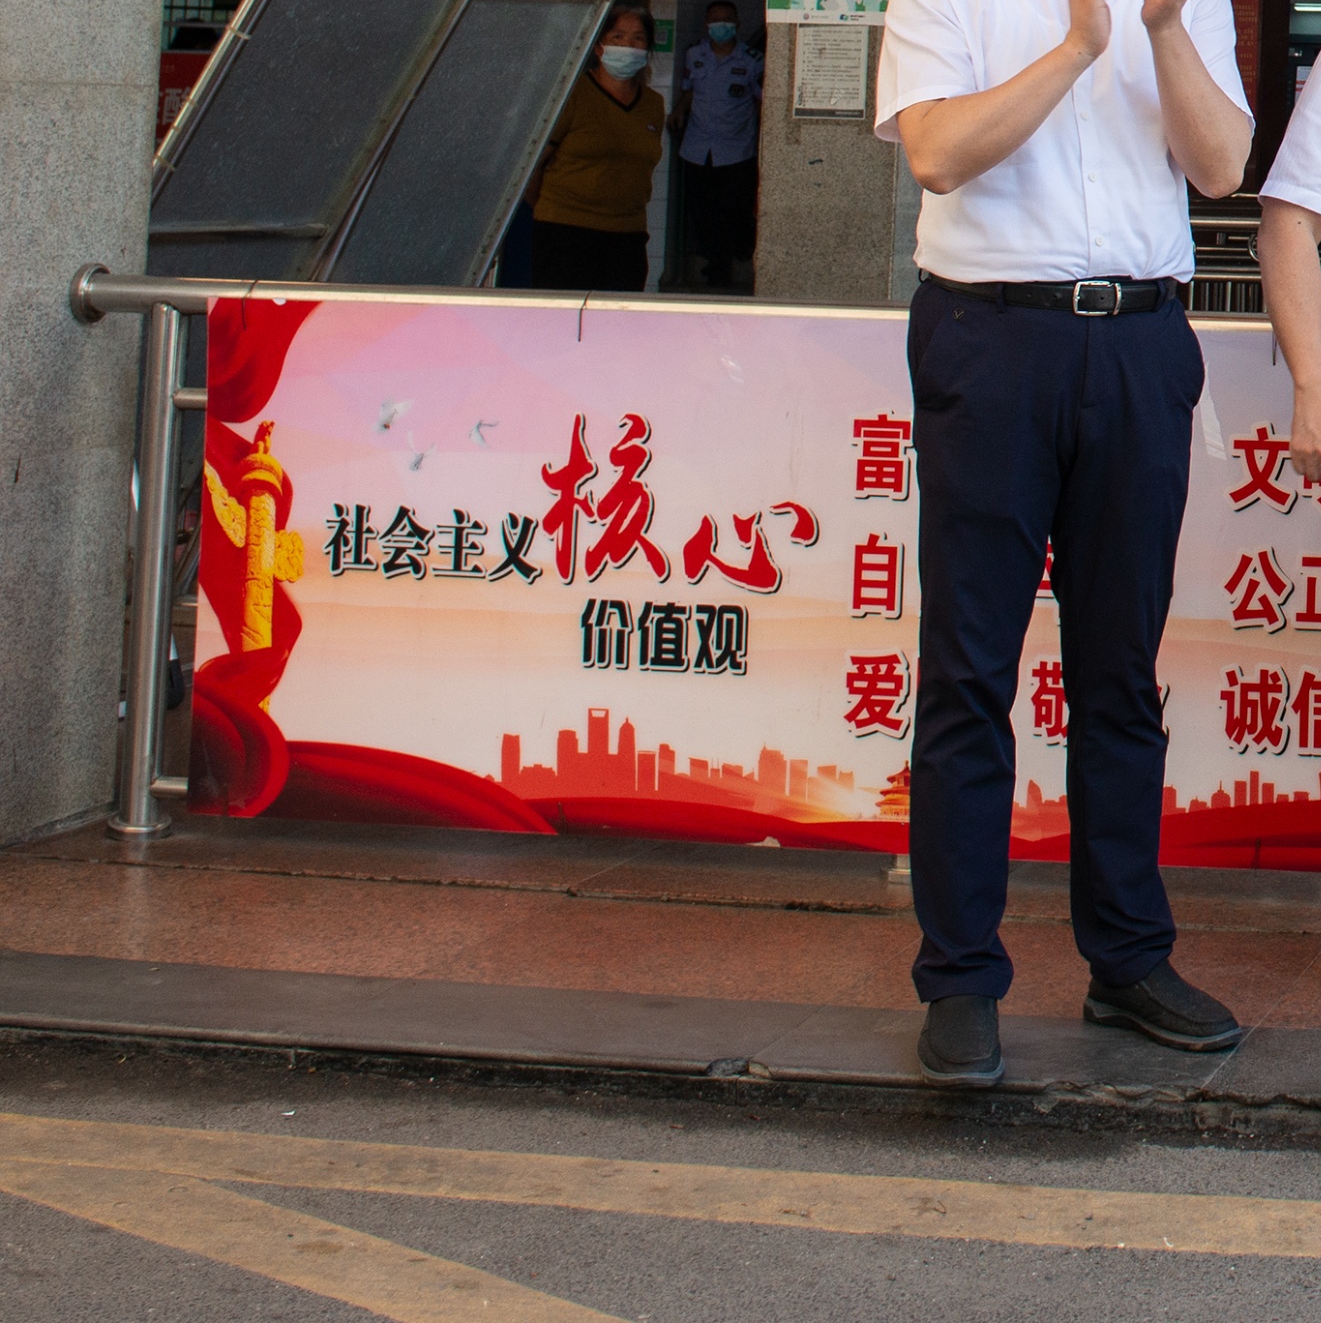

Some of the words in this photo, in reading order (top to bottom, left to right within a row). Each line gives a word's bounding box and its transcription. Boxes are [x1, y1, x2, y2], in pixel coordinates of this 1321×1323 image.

[852, 412, 912, 496] 富
[851, 533, 897, 614] 自
[581, 598, 747, 672] 价值观
[844, 652, 911, 733] 爱
